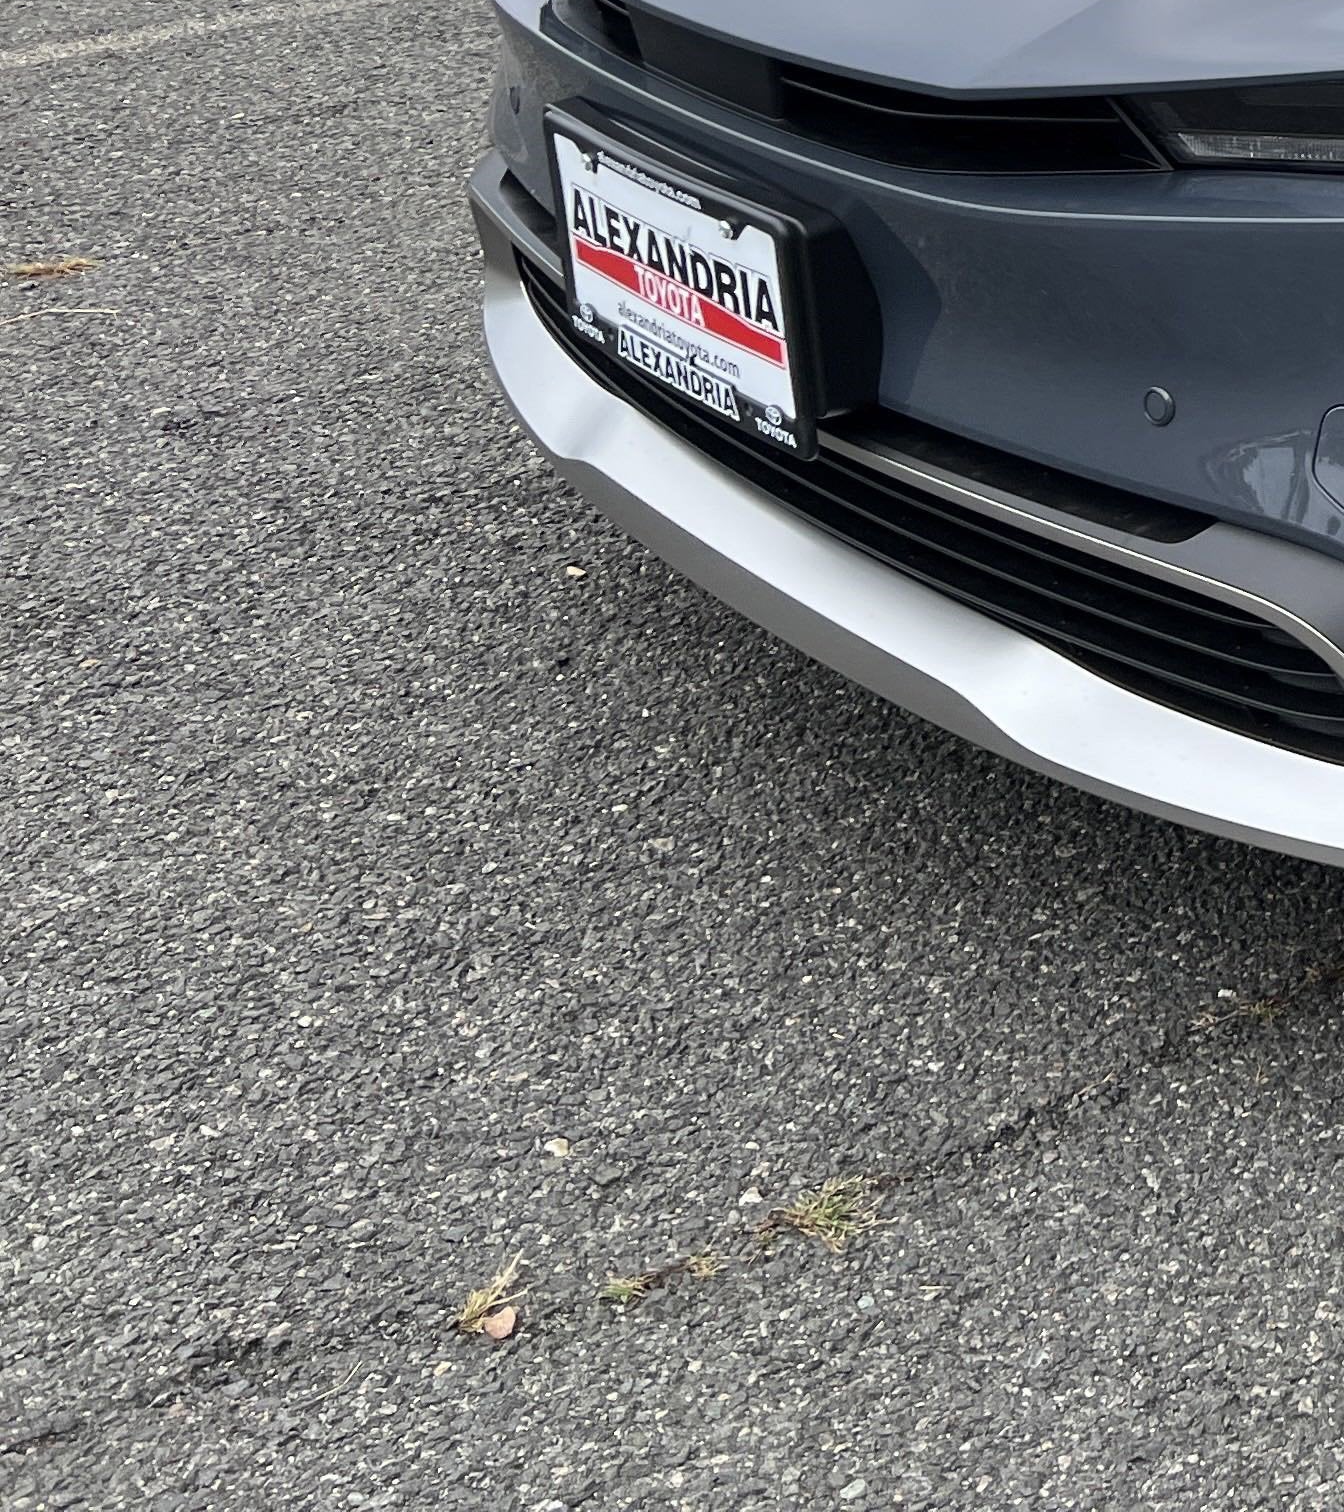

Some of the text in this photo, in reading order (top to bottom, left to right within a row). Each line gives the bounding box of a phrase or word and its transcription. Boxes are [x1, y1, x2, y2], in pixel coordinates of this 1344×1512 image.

[572, 187, 781, 334] ALEXANDRIA
[633, 263, 706, 328] TOYOTA
[572, 315, 605, 344] TOYOTA
[616, 300, 742, 380] alexandriatoyota.com
[618, 326, 740, 422] ALEXANDRIA
[754, 416, 798, 449] TOYOTA
